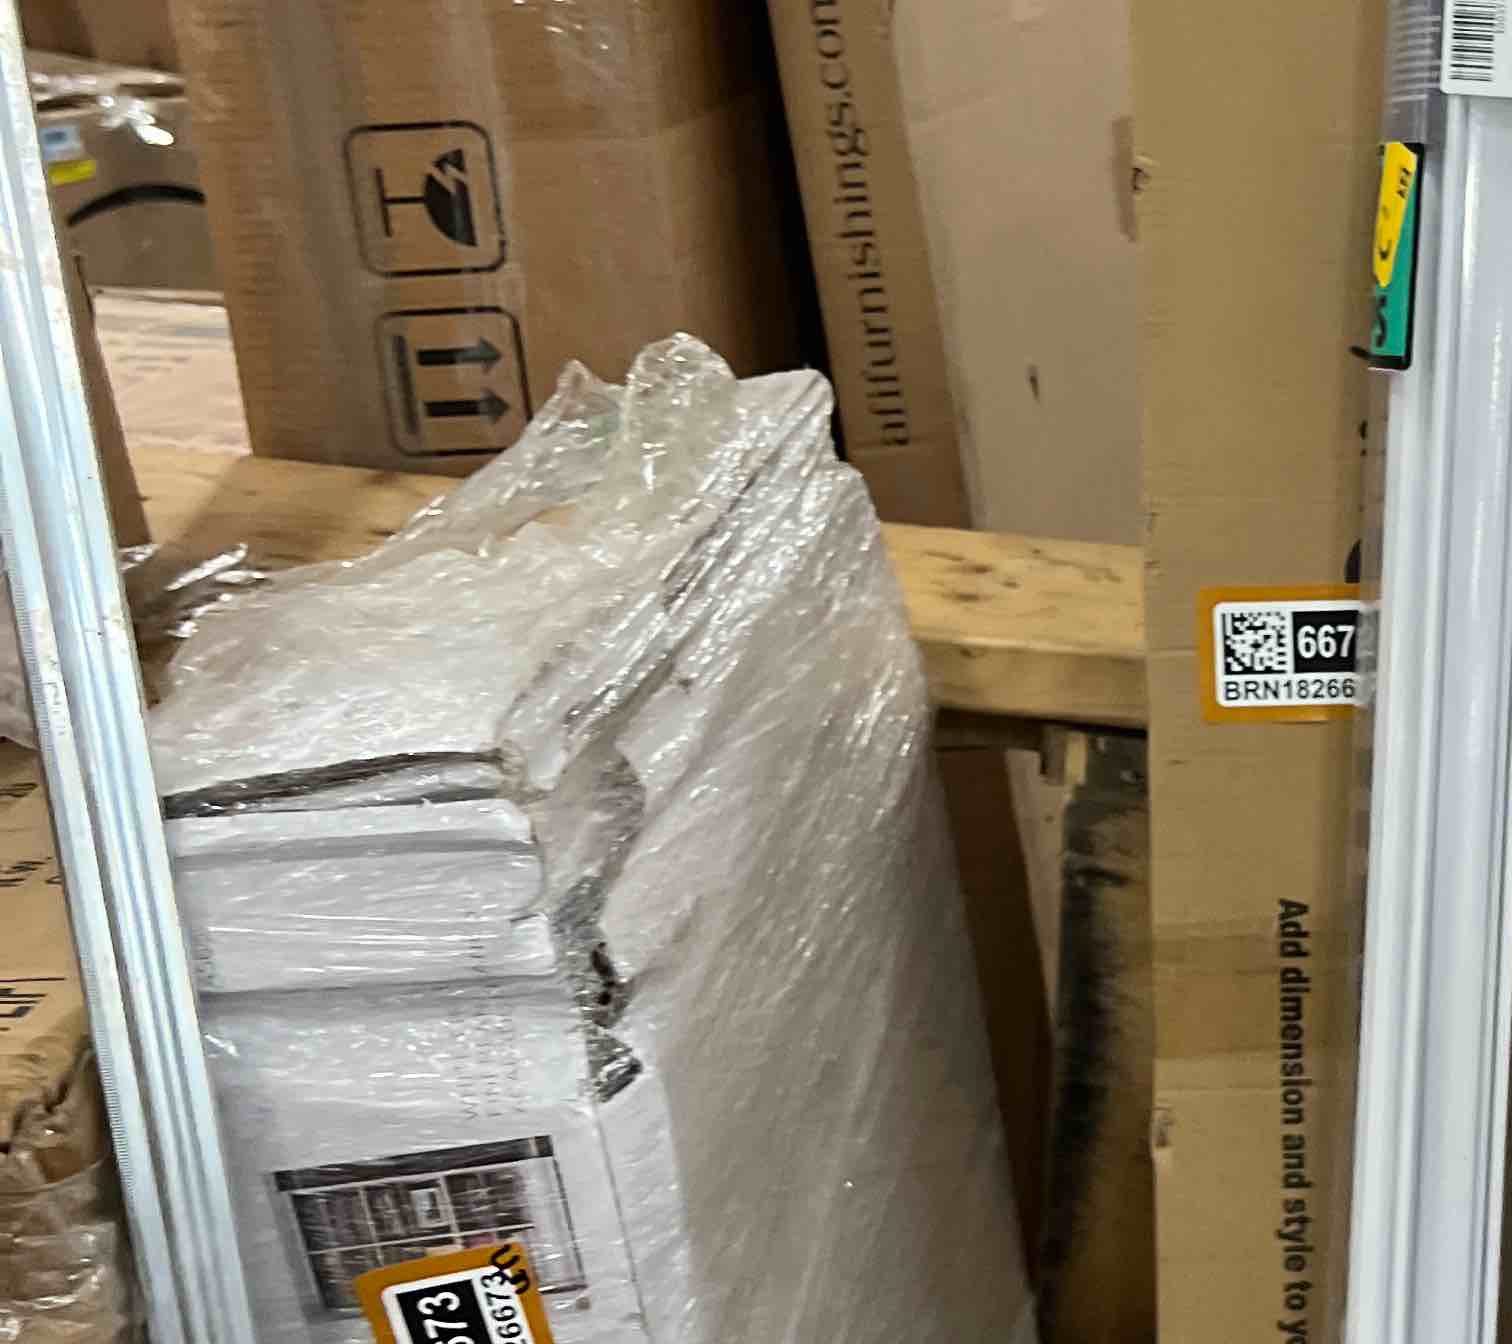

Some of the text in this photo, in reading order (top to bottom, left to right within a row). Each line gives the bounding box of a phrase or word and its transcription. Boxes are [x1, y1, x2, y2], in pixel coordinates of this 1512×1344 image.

[1296, 623, 1376, 660] 667
[1223, 677, 1376, 702] BRN18266
[1277, 898, 1311, 958] Add
[1278, 965, 1311, 1123] dimension
[1282, 1129, 1313, 1187] and
[1274, 1196, 1313, 1272] style
[1286, 1279, 1309, 1314] to
